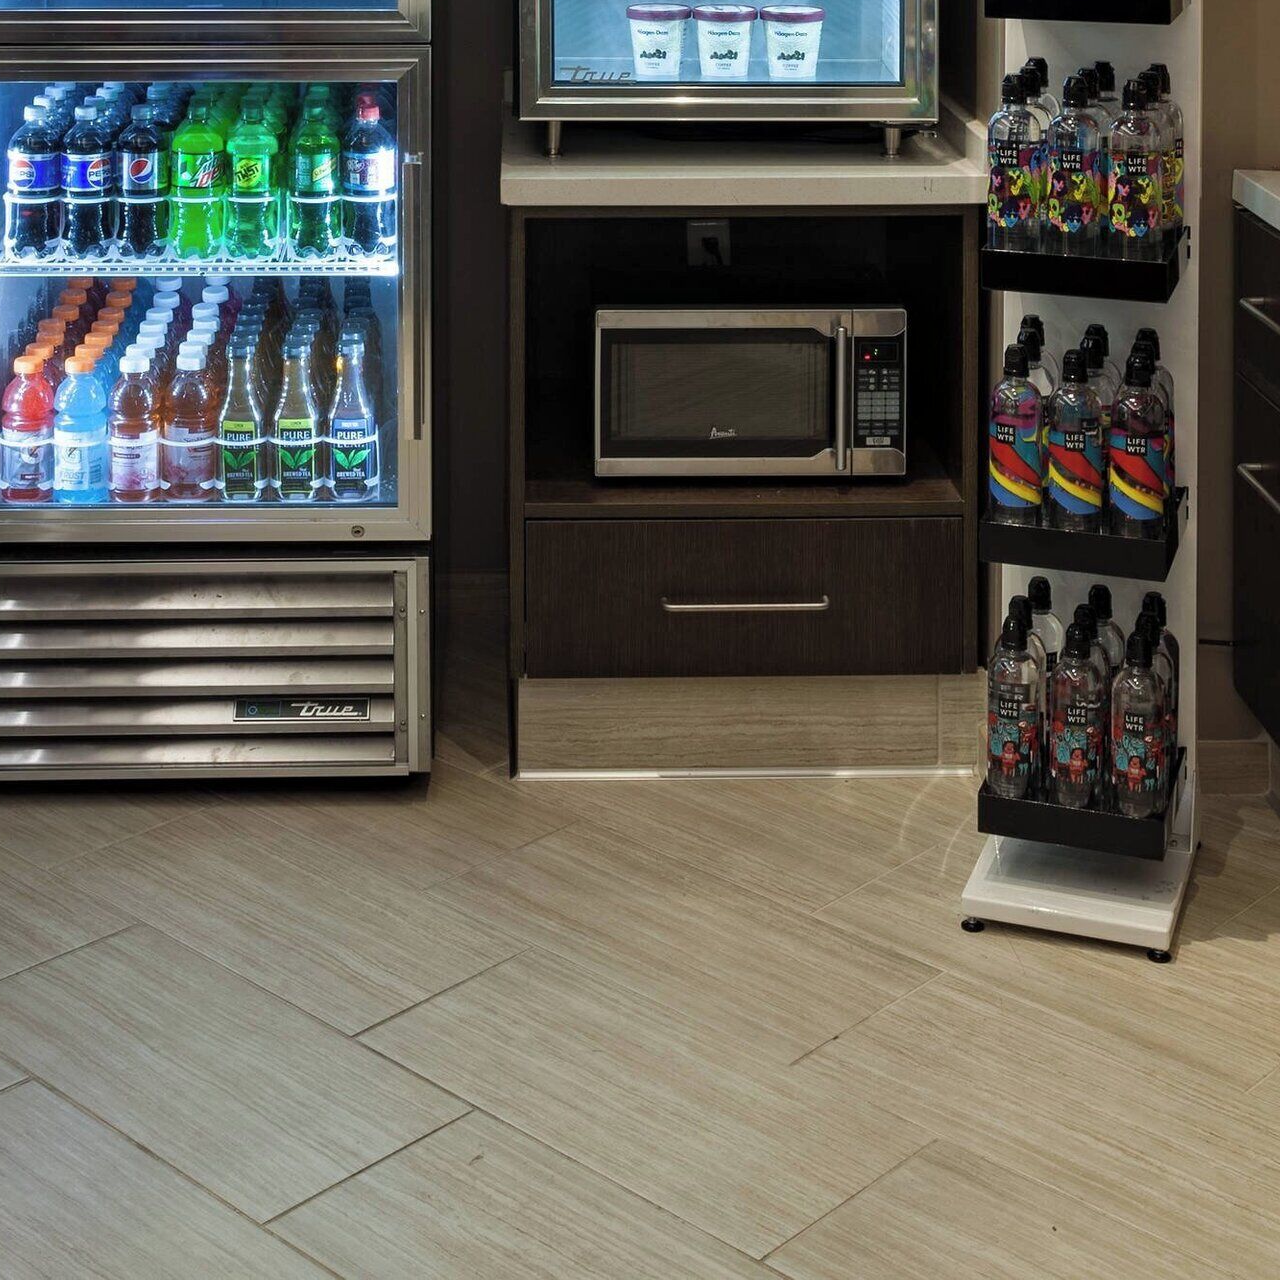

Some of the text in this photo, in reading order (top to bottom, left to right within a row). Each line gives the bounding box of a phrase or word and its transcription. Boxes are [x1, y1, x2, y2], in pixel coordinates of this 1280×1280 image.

[997, 426, 1014, 434] LIFE
[227, 432, 250, 441] PURE
[283, 431, 310, 440] PURE
[337, 431, 363, 440] PURE
[997, 434, 1014, 442] WTR
[1066, 434, 1084, 442] LIFE
[1127, 438, 1146, 446] LIFE
[1127, 446, 1146, 454] WTR
[1000, 701, 1017, 709] LIFE
[1000, 709, 1018, 717] WTR
[1125, 715, 1143, 723] LIFE
[1125, 723, 1144, 731] WTR
